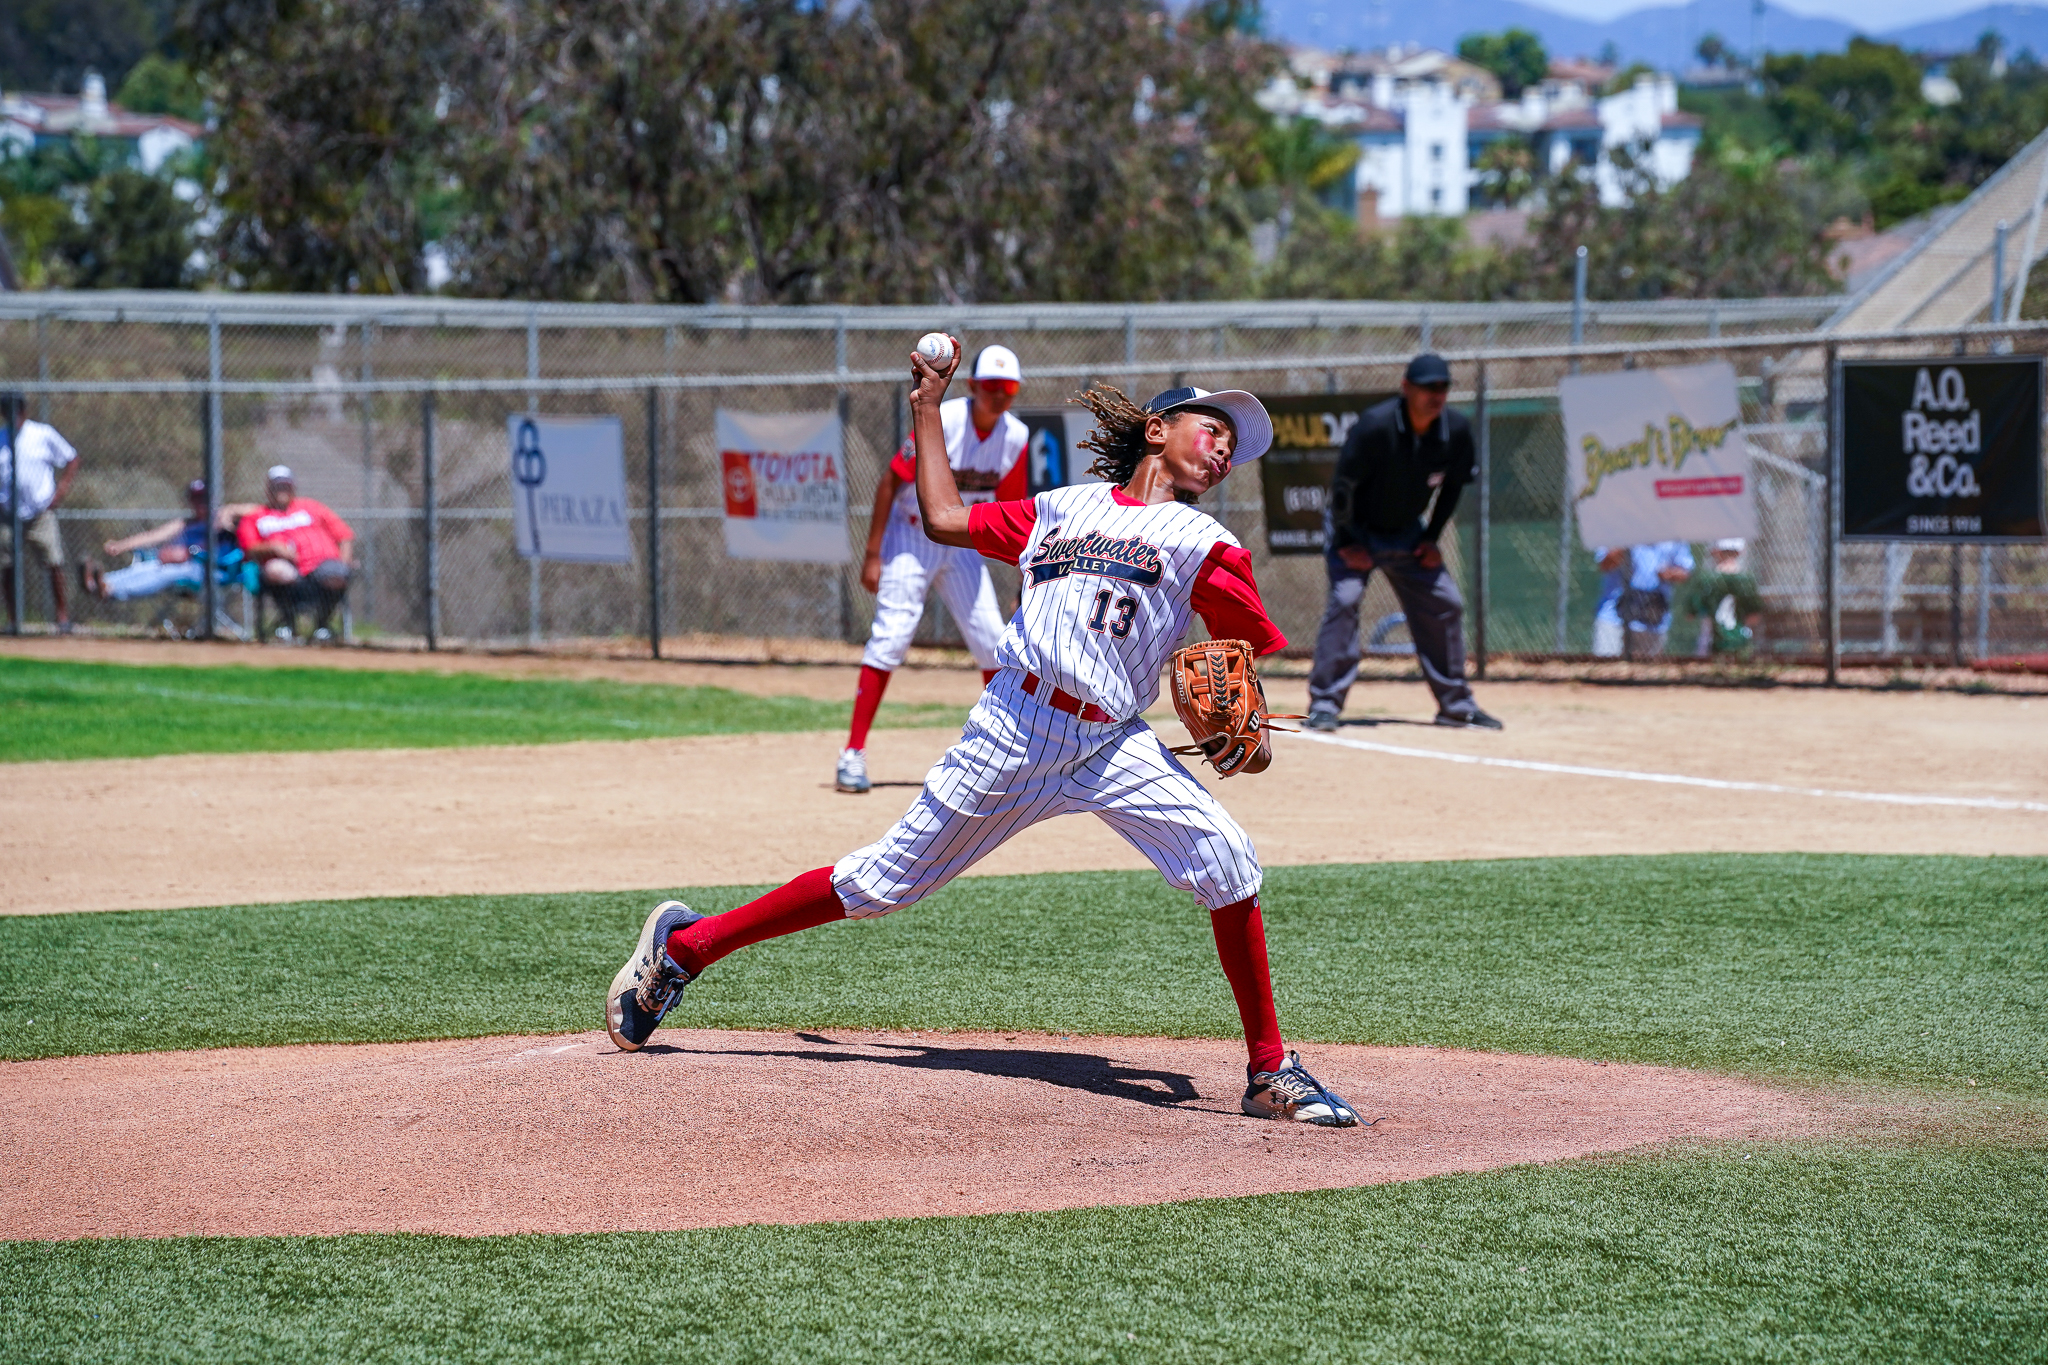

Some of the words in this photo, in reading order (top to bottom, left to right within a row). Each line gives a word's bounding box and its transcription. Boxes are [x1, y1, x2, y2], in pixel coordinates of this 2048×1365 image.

[1911, 367, 1970, 411] A.O.
[1902, 409, 1981, 453] Reed
[752, 451, 839, 483] TOYOTA
[1906, 453, 1981, 498] &Co.
[1906, 515, 1949, 534] SINCE
[1030, 526, 1163, 572] Sweetwater
[1058, 557, 1112, 575] VALLEY
[1088, 589, 1138, 639] 13
[1220, 744, 1245, 771] Wilson
